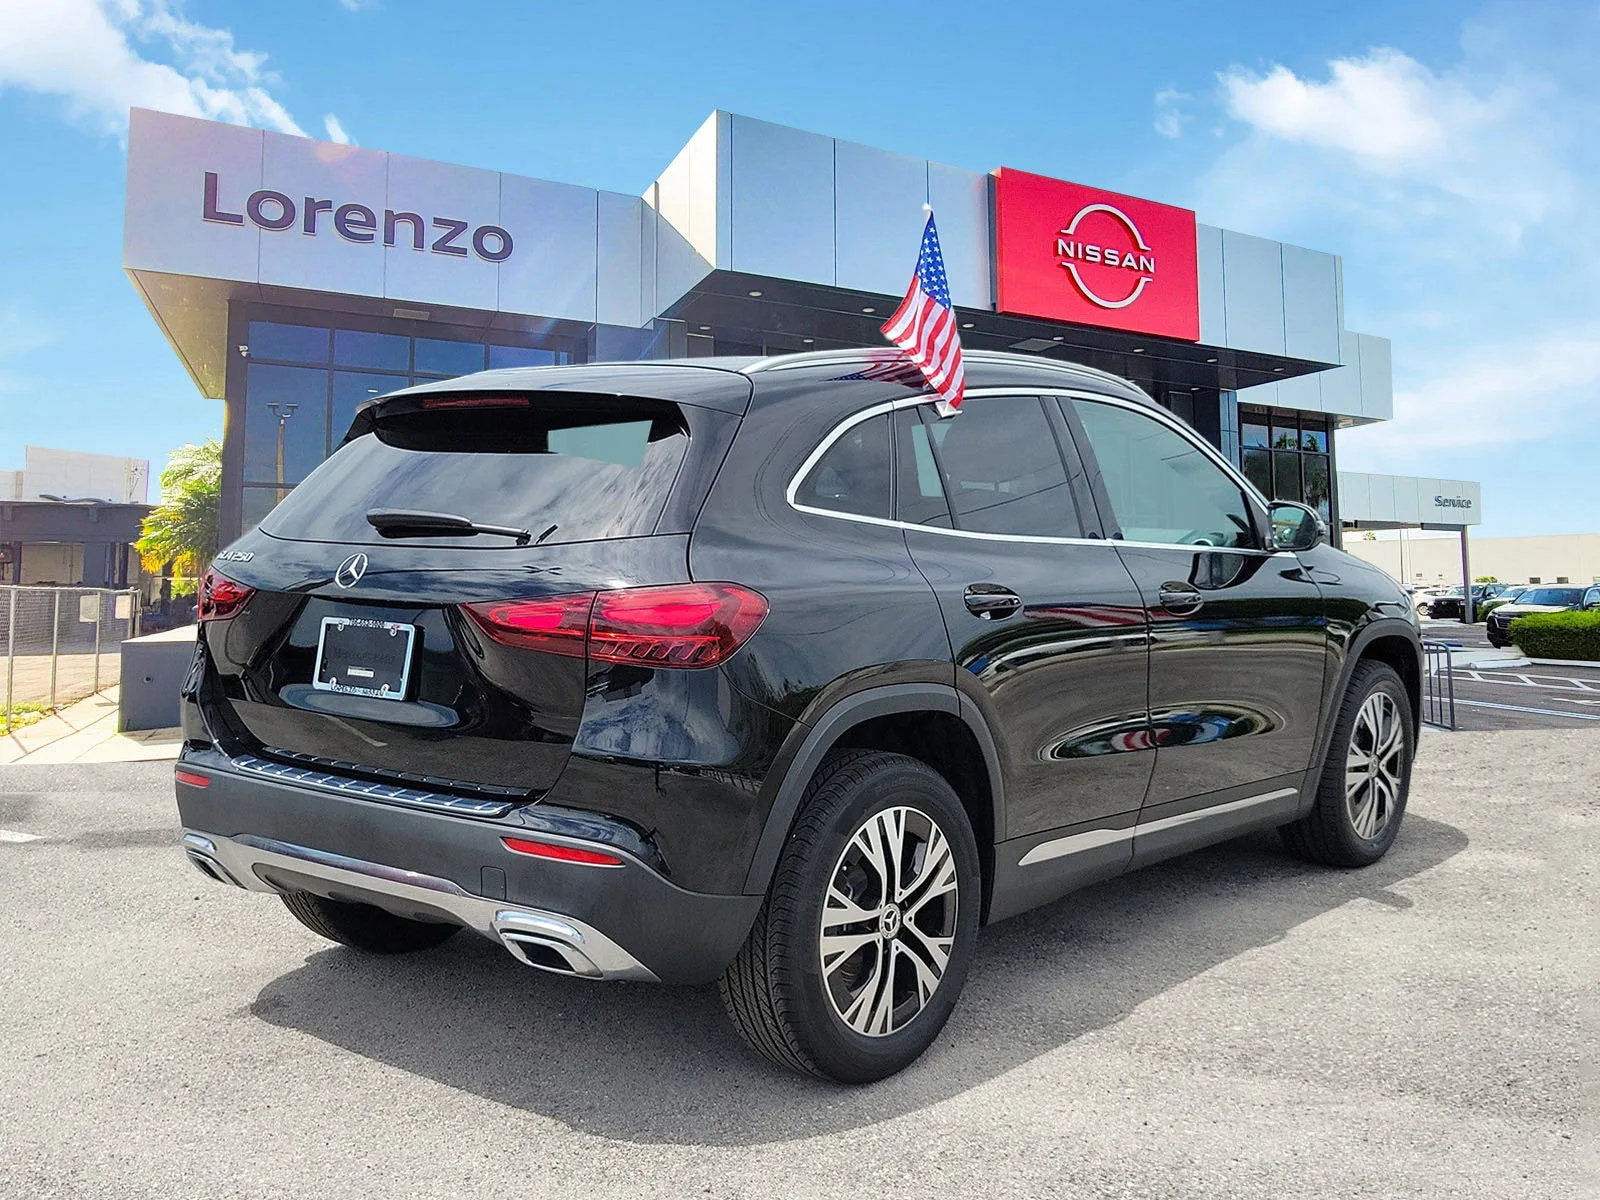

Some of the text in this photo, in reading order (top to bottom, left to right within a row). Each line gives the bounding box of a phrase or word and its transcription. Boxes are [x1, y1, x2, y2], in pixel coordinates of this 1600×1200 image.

[203, 170, 515, 263] Lorenzo
[1056, 238, 1155, 274] NISSAN
[1434, 495, 1472, 509] Service
